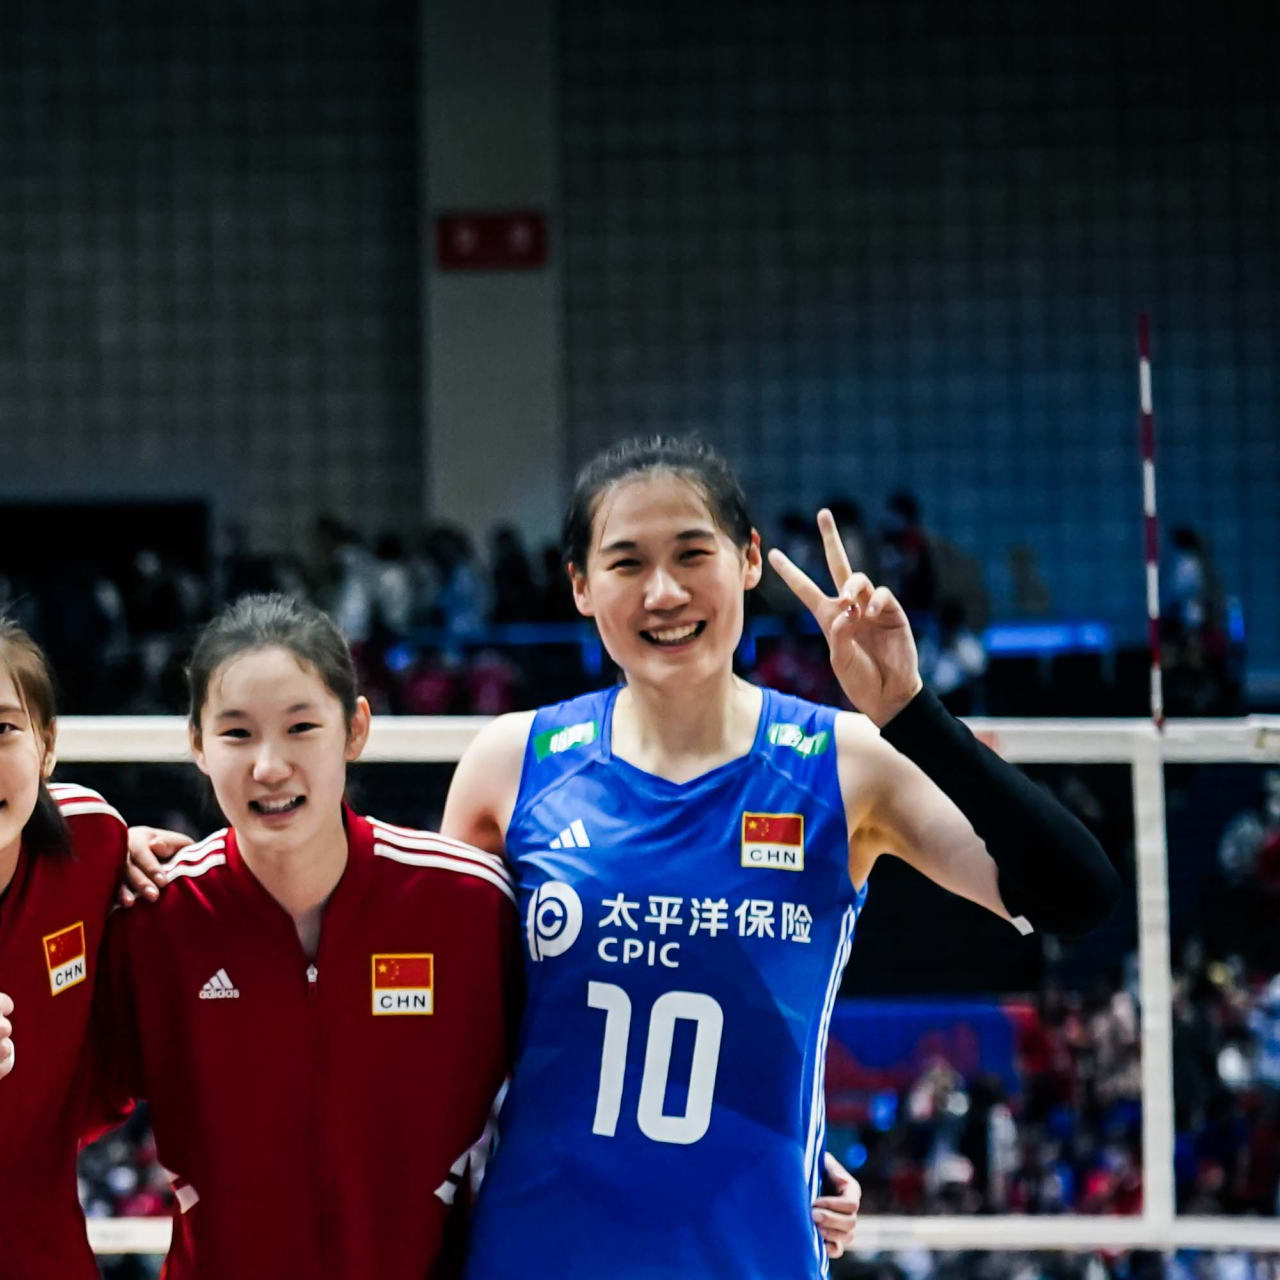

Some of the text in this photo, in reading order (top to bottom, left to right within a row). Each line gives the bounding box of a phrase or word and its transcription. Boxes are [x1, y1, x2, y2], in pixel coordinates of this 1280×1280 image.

[750, 849, 797, 865] CHN
[598, 893, 813, 944] 太平洋保险
[597, 937, 681, 968] CPIC
[55, 963, 83, 986] CHN
[199, 988, 240, 999] adidas
[379, 995, 426, 1009] CHN
[587, 980, 724, 1145] 10
